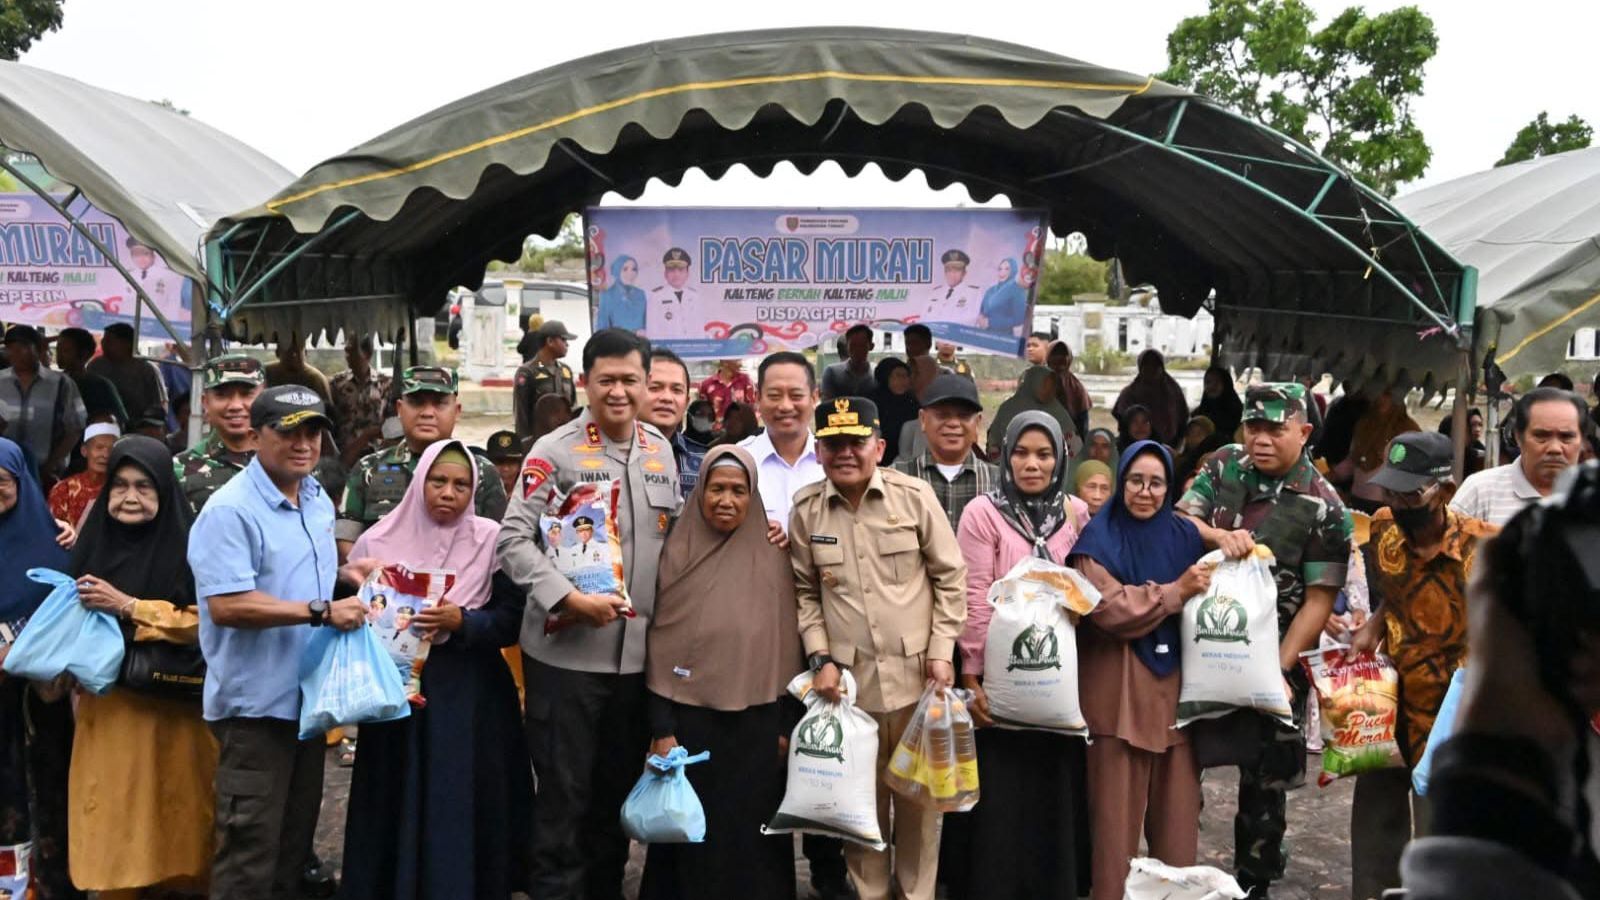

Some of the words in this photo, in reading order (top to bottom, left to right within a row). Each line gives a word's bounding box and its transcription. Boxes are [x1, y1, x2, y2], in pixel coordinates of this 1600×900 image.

[700, 237, 810, 284] PASAR
[814, 237, 933, 284] MURAH
[7, 271, 59, 283] KALTENG
[724, 288, 775, 300] KALTENG
[823, 288, 874, 300] KALTENG
[875, 288, 908, 300] MAJU
[757, 306, 877, 321] DISDAGPERIN
[580, 472, 611, 483] IWAN
